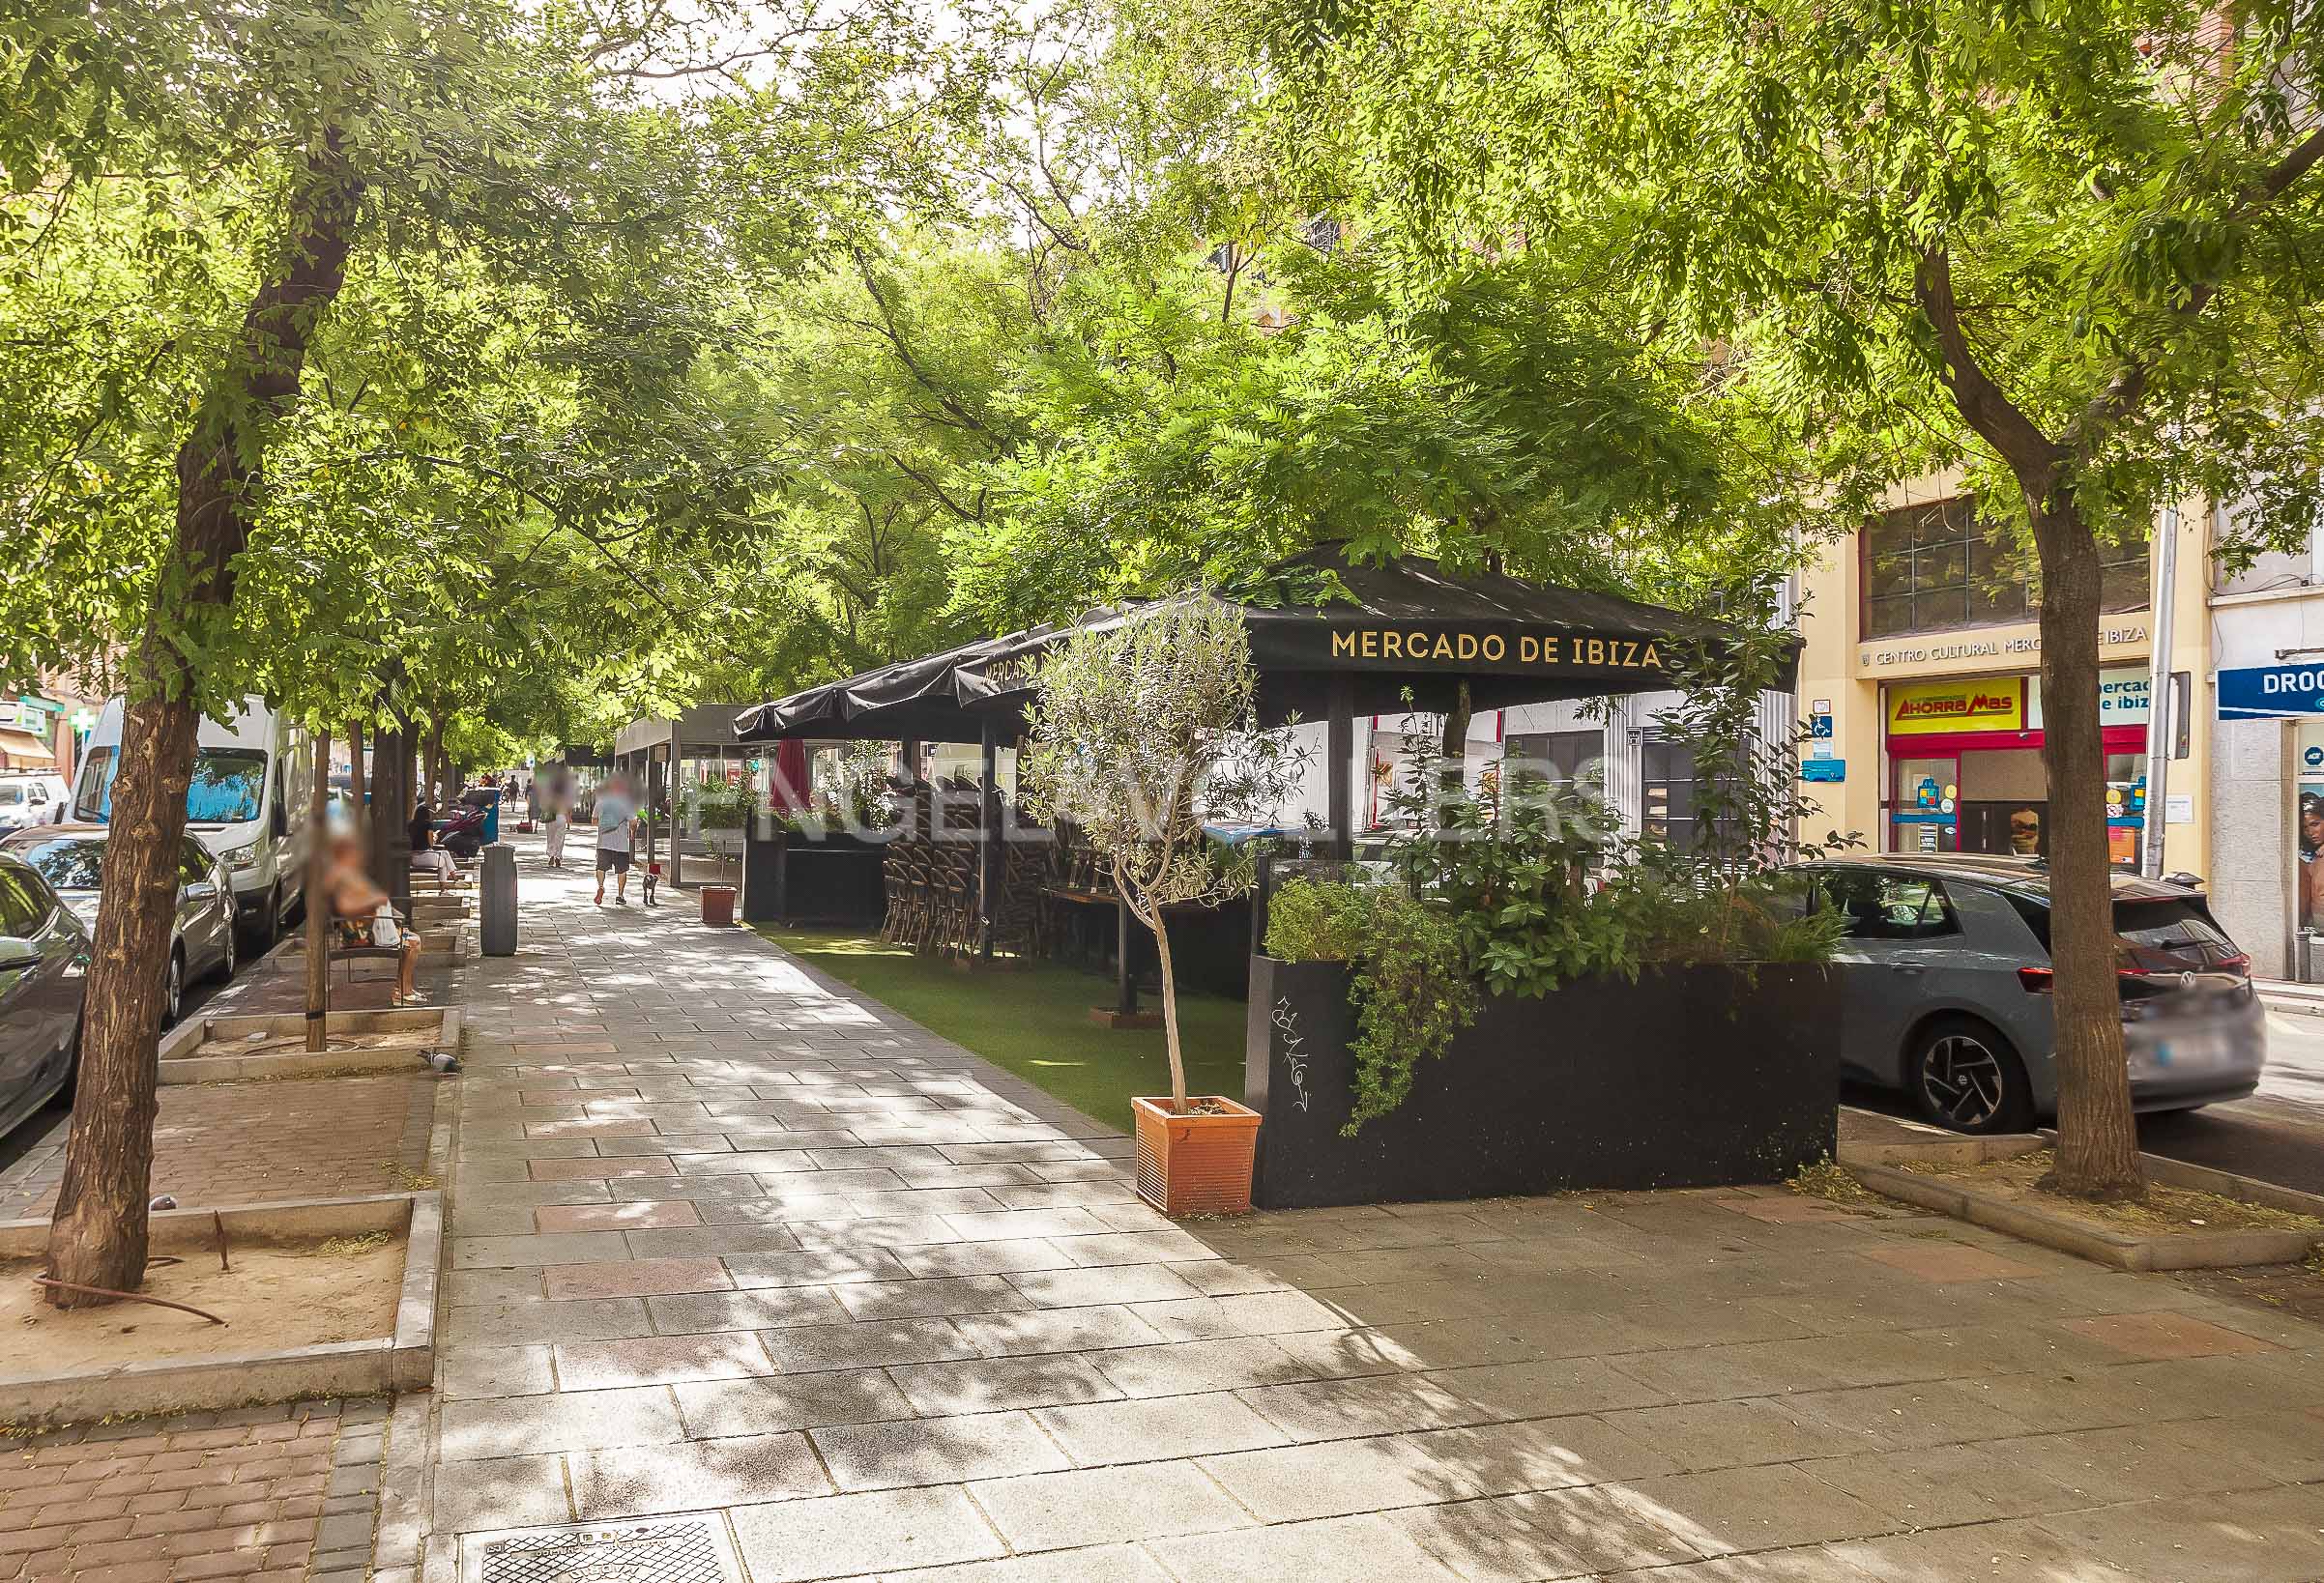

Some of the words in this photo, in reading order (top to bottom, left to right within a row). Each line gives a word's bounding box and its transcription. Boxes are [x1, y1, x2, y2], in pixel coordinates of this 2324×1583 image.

[1331, 629, 1505, 661] MERCADO
[1520, 635, 1559, 664] DE
[1572, 637, 1664, 669] IBIZA
[1874, 648, 1927, 665] CENTRO
[1930, 641, 1998, 661] CULTURAL
[2003, 638, 2042, 654] MERC
[2106, 626, 2149, 644] IBIZA
